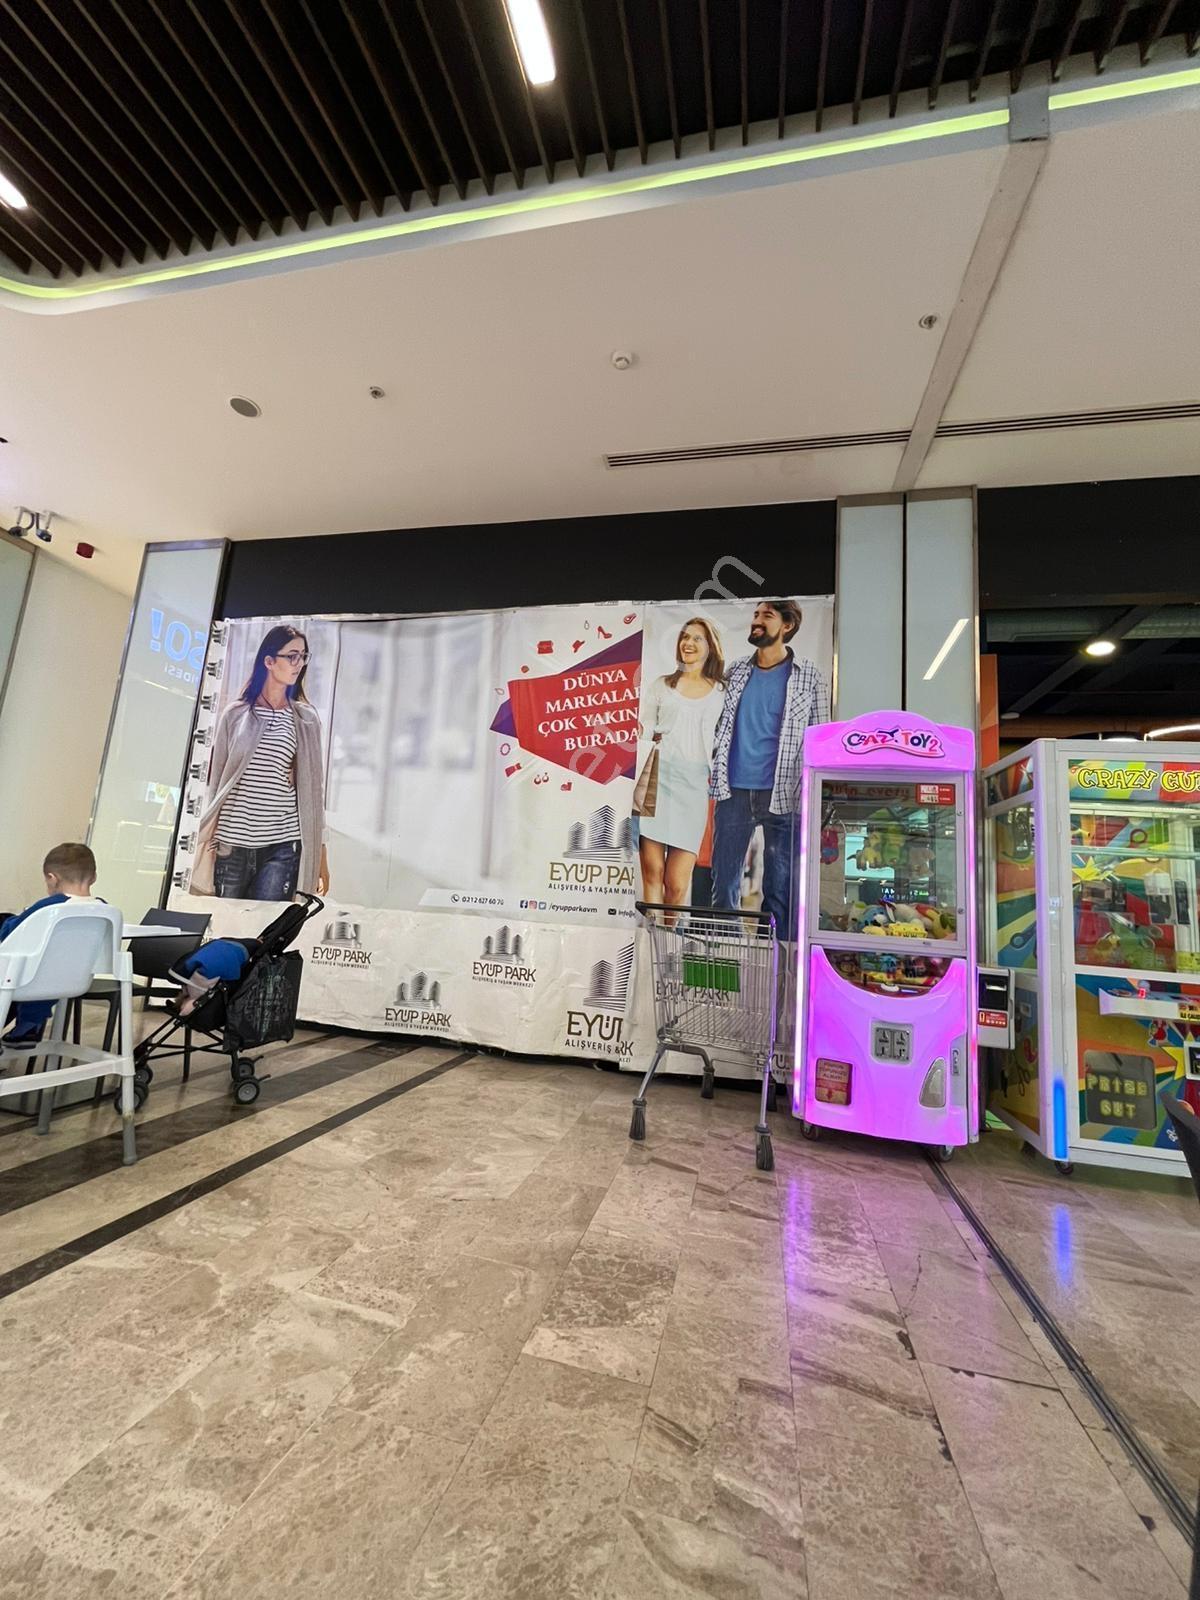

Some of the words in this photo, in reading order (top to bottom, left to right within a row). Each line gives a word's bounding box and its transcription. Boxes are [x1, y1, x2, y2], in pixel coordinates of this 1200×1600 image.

[563, 669, 627, 691] DÜNYA
[538, 716, 578, 738] ÇOK
[564, 727, 640, 751] BURADA
[1077, 767, 1157, 792] CRAZY
[550, 862, 602, 883] EYÜP
[312, 946, 341, 960] EYÜP
[343, 949, 373, 964] PARK
[473, 961, 503, 978] EYÜP
[504, 965, 537, 983] PARK
[385, 1007, 419, 1024] EYÜP
[421, 1011, 452, 1028] PARK
[564, 1038, 612, 1054] ALIŞVERİŞ
